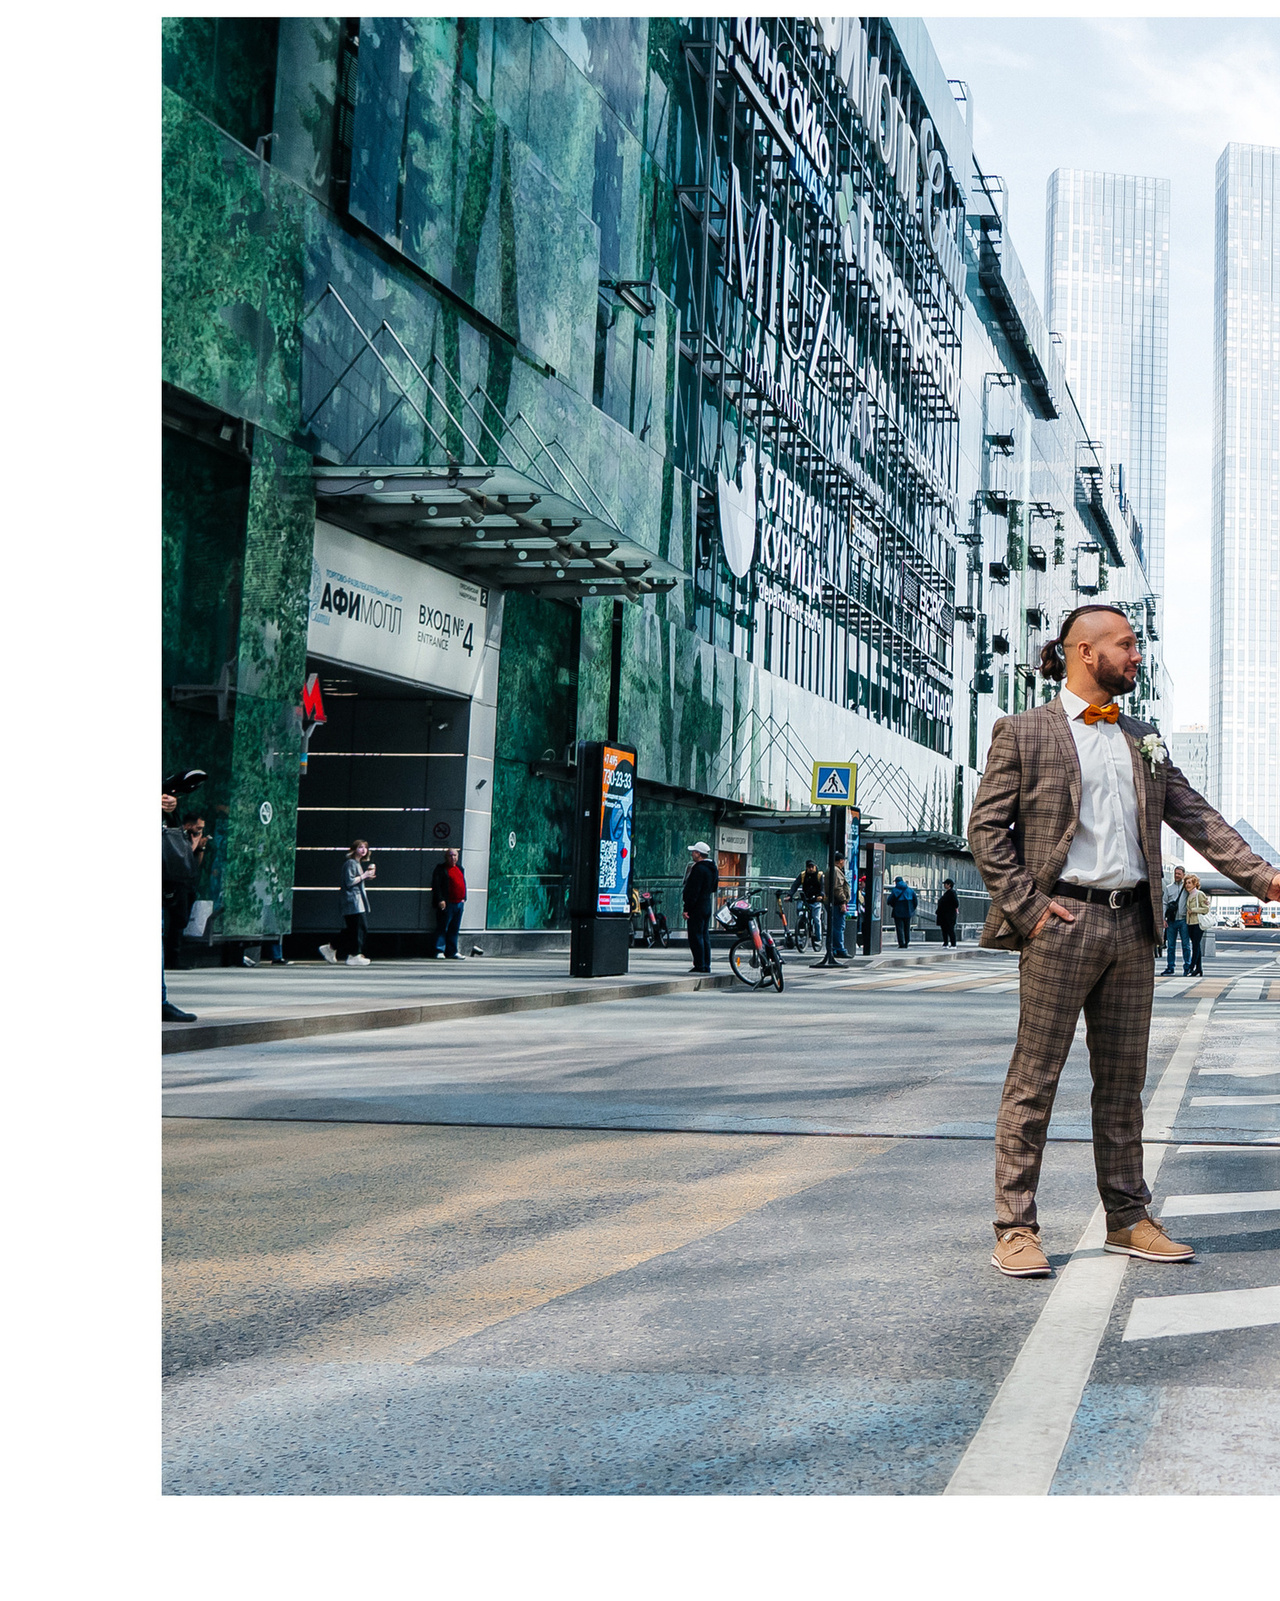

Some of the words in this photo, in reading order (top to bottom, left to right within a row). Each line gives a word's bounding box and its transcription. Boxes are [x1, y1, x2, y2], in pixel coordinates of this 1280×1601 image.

[744, 346, 805, 431] DIAMONDS
[762, 462, 823, 548] СЛЕПАЯ
[760, 519, 823, 606] КУРИЦА
[320, 582, 402, 635] АФИМОЛЛ
[482, 592, 487, 604] 2
[759, 580, 804, 621] department
[417, 631, 449, 651] ENTRANCE
[419, 604, 451, 638] ВХОД
[452, 616, 464, 637] №
[463, 622, 473, 657] 4
[603, 768, 632, 789] 730-23-33
